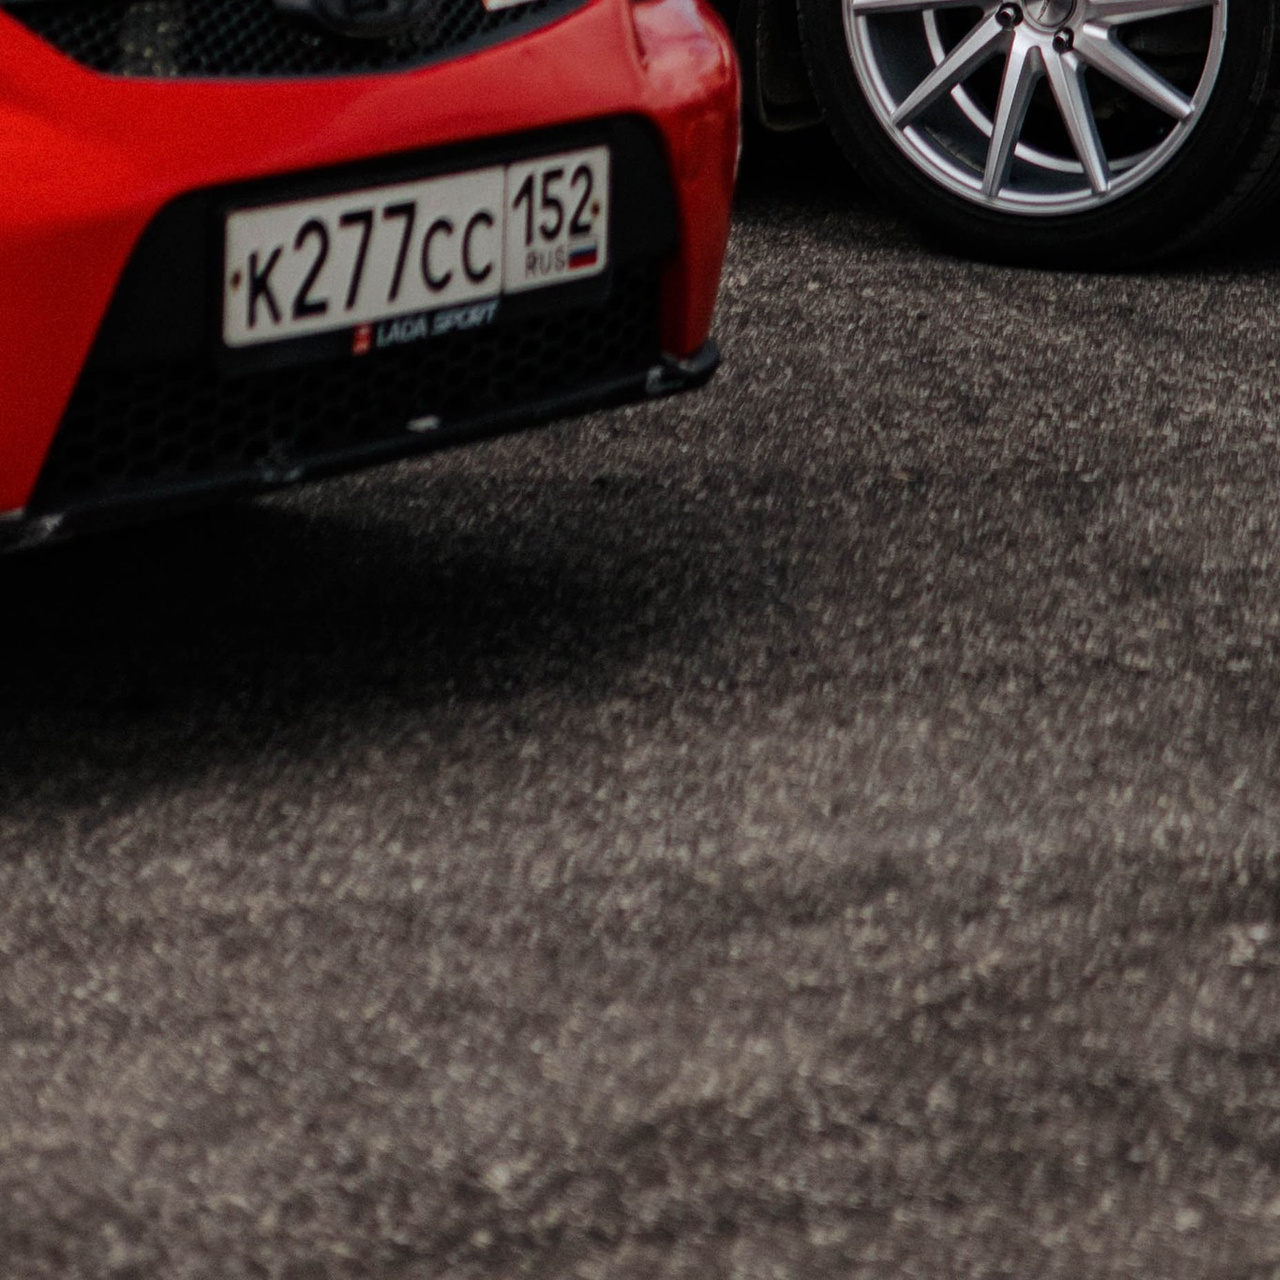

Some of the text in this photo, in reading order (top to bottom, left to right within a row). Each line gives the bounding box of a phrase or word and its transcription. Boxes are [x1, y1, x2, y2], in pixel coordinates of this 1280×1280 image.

[247, 165, 594, 329] K277CC 152
[525, 245, 565, 277] RUS
